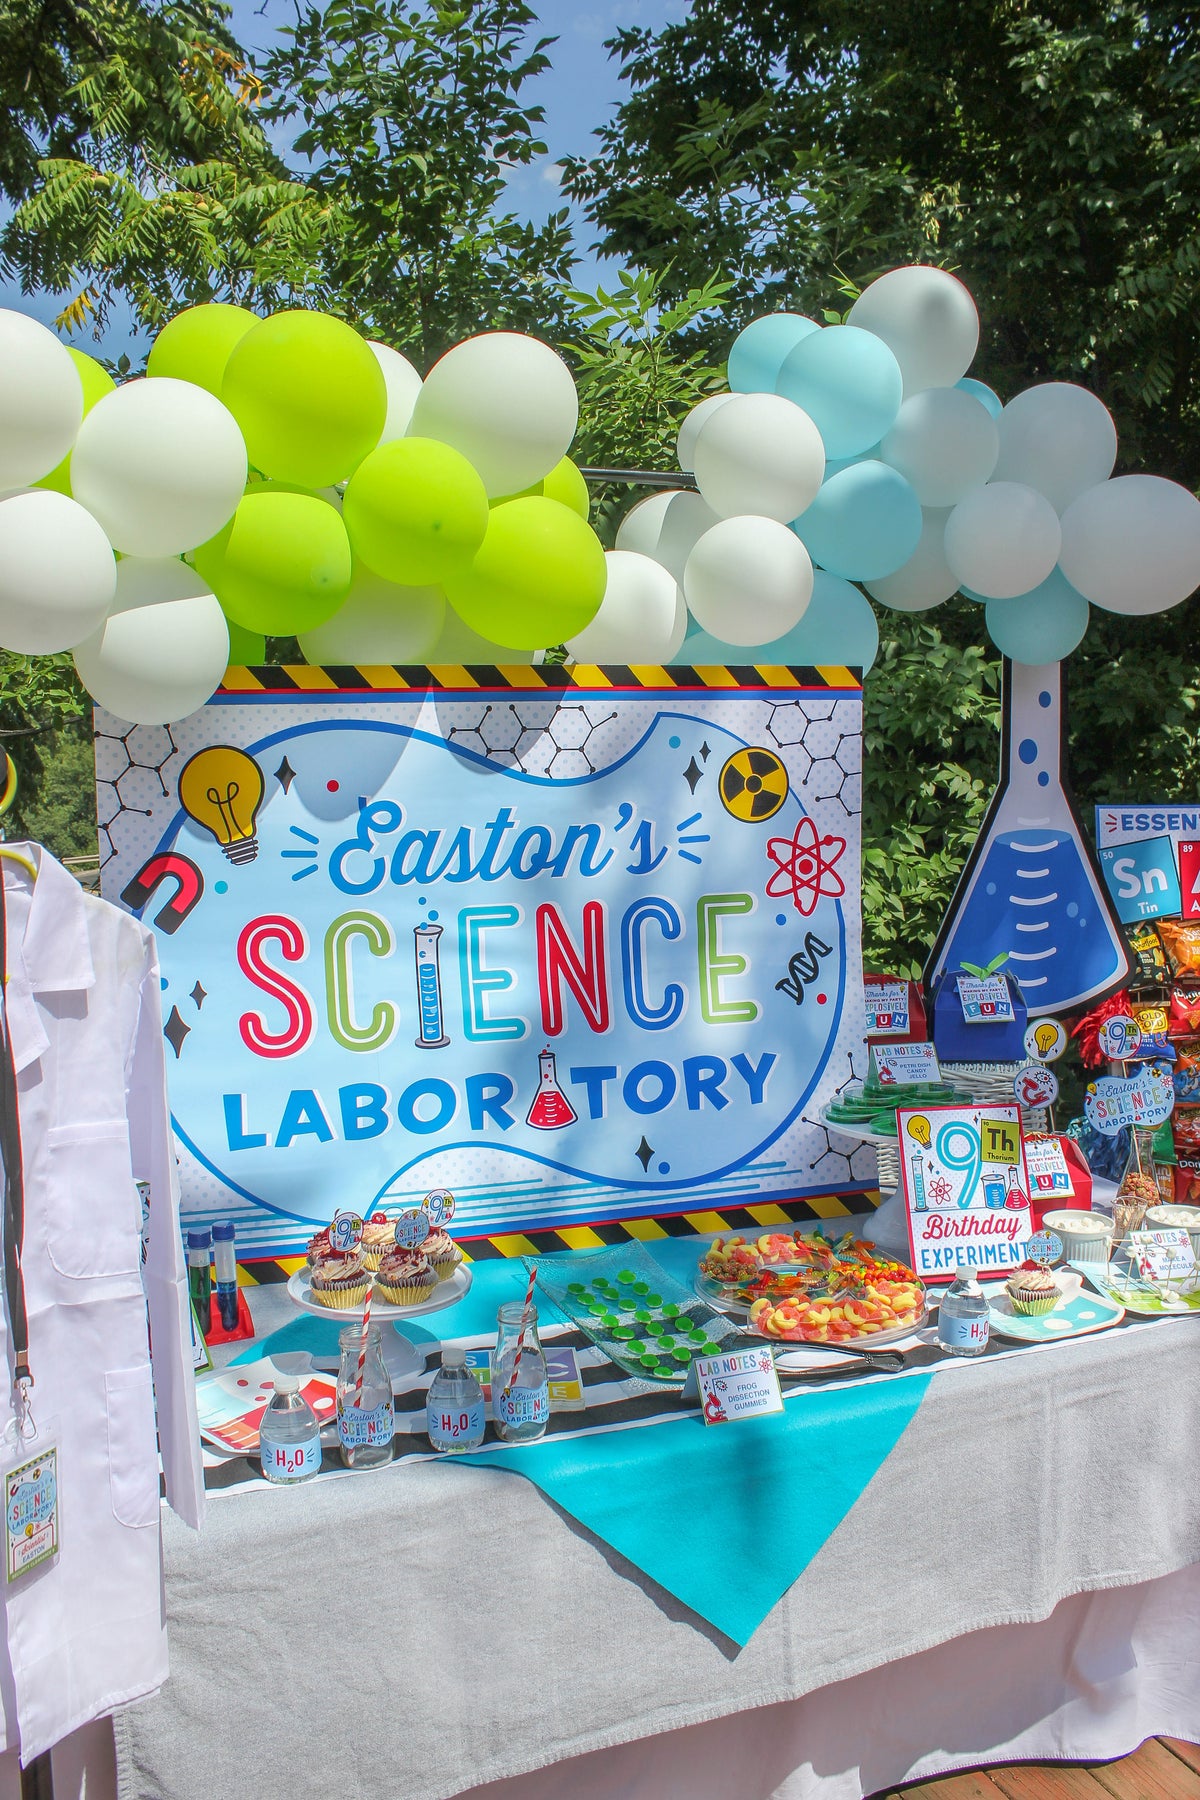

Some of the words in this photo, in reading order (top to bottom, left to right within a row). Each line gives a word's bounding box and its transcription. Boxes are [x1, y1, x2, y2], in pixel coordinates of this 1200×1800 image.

[1121, 814, 1200, 831] ESSEN
[328, 796, 669, 896] Easton's
[1182, 844, 1194, 853] 89
[1103, 851, 1114, 860] 50
[1112, 858, 1168, 899] Sn
[1137, 901, 1159, 915] Tin
[236, 892, 759, 1059] SCIENCE
[988, 981, 998, 989] for
[889, 990, 899, 998] for
[865, 1002, 907, 1012] XPLOSIVELY
[969, 1003, 1007, 1013] FUN
[1109, 1021, 1126, 1054] 9
[1128, 1025, 1137, 1033] Th
[875, 1048, 892, 1057] LAB
[894, 1046, 922, 1056] NOTES
[1105, 1080, 1147, 1098] Easton's
[987, 1152, 1015, 1161] Thorium
[936, 1121, 982, 1210] 9
[987, 1128, 1014, 1152] Th
[430, 1195, 444, 1223] 9
[444, 1198, 452, 1206] Th
[337, 1219, 352, 1247] 9
[922, 1214, 1023, 1241] Birthday
[921, 1241, 1028, 1269] EXPERIMENT
[699, 1360, 720, 1377] LAB
[722, 1354, 757, 1373] NOTES
[737, 1382, 758, 1391] FROG
[728, 1389, 770, 1402] DISSECTION
[734, 1398, 768, 1411] GUMMIES
[349, 1411, 381, 1421] Easton's
[341, 1417, 389, 1436] SCIENCE
[13, 1485, 51, 1521] SCIENCE
[22, 1544, 46, 1563] EASTON
